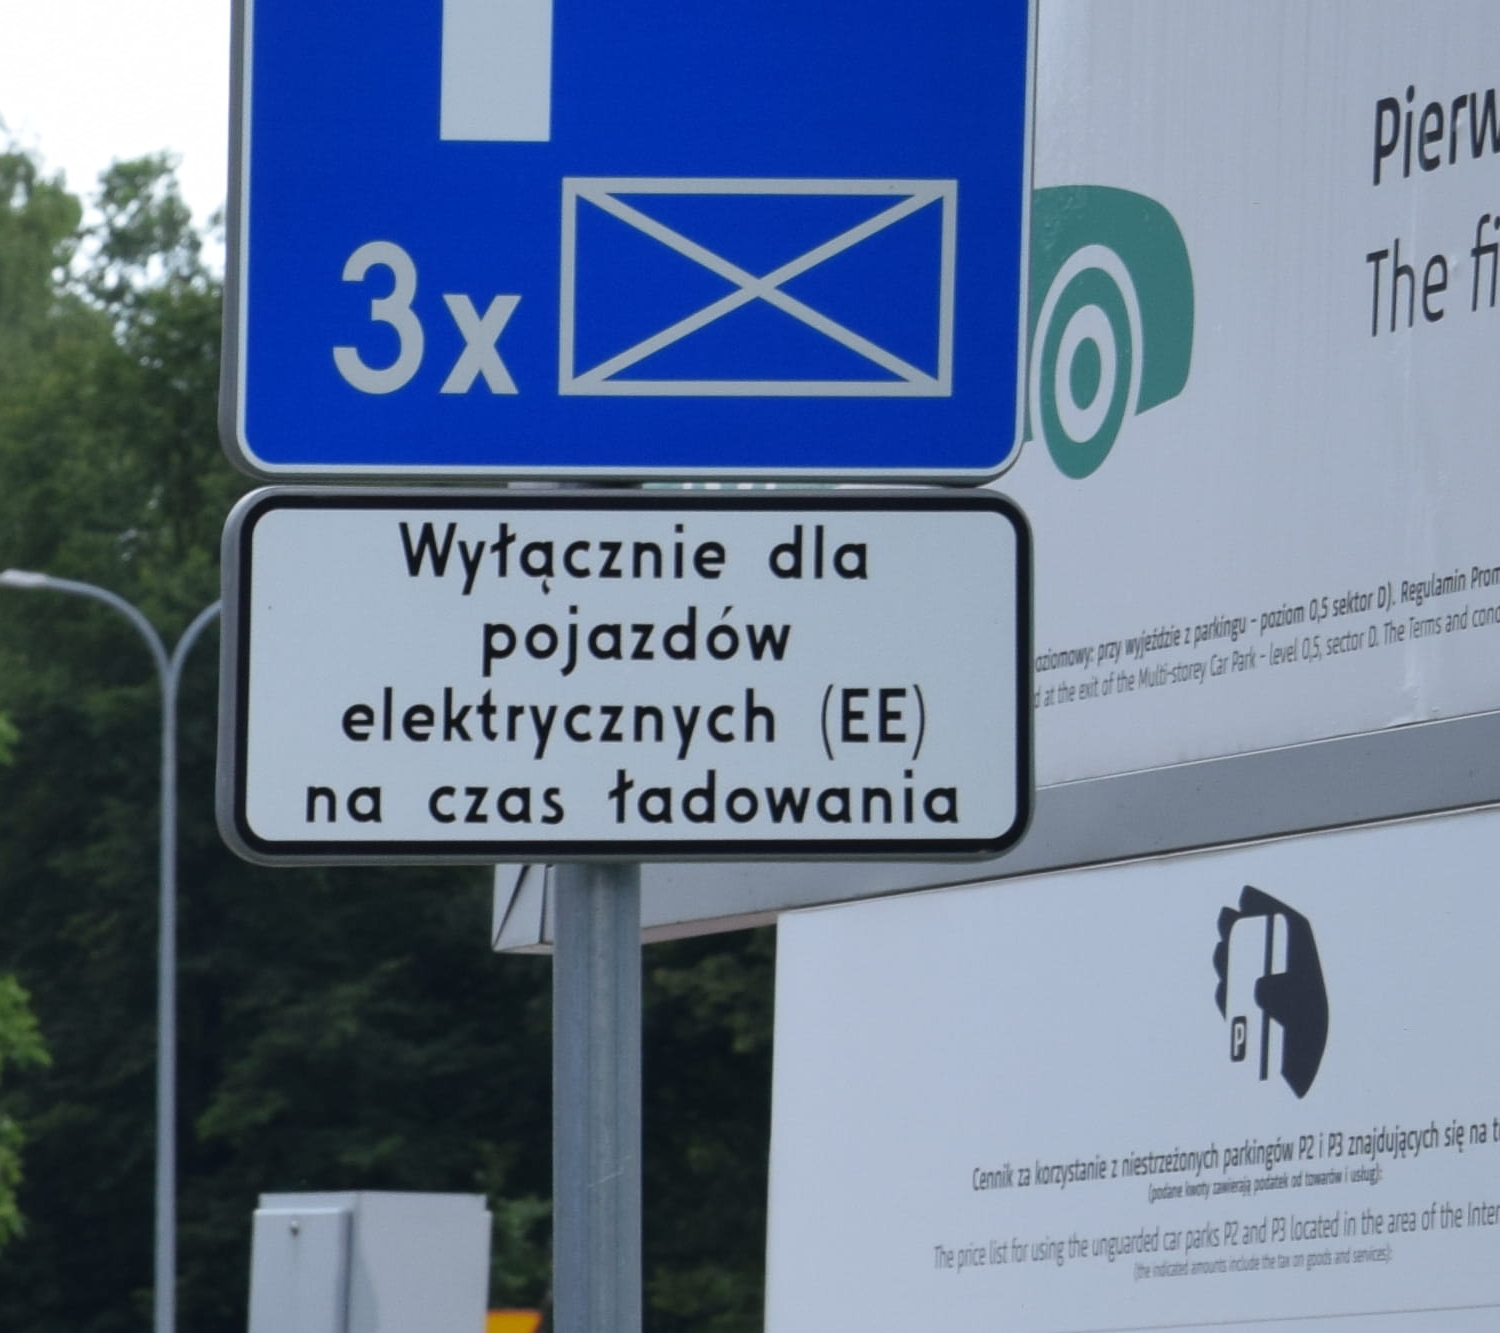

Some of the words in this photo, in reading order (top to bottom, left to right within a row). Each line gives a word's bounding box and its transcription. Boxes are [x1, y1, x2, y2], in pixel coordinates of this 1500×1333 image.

[332, 240, 522, 395] 3x
[1365, 237, 1449, 338] The
[399, 521, 727, 597] Wyłącznie
[769, 524, 870, 581] dla
[482, 604, 792, 678] pojazdów
[1097, 640, 1122, 666] przy
[1183, 629, 1191, 645] z
[1193, 614, 1247, 648] parkingu
[1260, 602, 1305, 637] poziom
[1308, 596, 1329, 625] 0,5
[1331, 589, 1374, 618] sektor
[1376, 580, 1397, 612] D).
[1400, 568, 1467, 606] Regulamin
[1043, 685, 1056, 707] at
[1057, 680, 1075, 703] the
[1078, 675, 1099, 701] exit
[1101, 671, 1114, 697] of
[1116, 669, 1135, 693] the
[1138, 661, 1206, 689] Multi-storey
[1209, 653, 1229, 677] Car
[1231, 645, 1257, 673] Park
[1269, 638, 1298, 666] level
[1302, 635, 1323, 664] 0,5,
[1325, 631, 1365, 657] sector
[1367, 625, 1380, 649] D.
[1383, 618, 1405, 646] The
[1408, 614, 1442, 640] Terms
[1445, 604, 1468, 634] and
[341, 686, 777, 760] elektrycznych
[820, 684, 927, 761] (EE)
[305, 785, 383, 825] na
[429, 785, 566, 826] czas
[608, 769, 960, 825] ładowania
[1233, 1022, 1245, 1057] P
[972, 1162, 1015, 1192] Cennik
[1017, 1167, 1031, 1188] za
[1034, 1154, 1108, 1190] korzystanie
[1110, 1159, 1118, 1180] z
[1121, 1143, 1219, 1178] niestrzeżonych
[1222, 1137, 1295, 1174] parkingów
[1298, 1132, 1315, 1161] P2
[1318, 1131, 1324, 1159] i
[1327, 1131, 1344, 1158] P3
[1347, 1120, 1440, 1162] znajdujących
[1443, 1118, 1465, 1154] się
[1469, 1122, 1488, 1146] na
[1253, 1173, 1289, 1194] podatek
[1291, 1170, 1302, 1189] od
[934, 1244, 955, 1270] The
[957, 1242, 987, 1274] price
[988, 1238, 1009, 1266] list
[1011, 1237, 1029, 1264] for
[1031, 1235, 1066, 1267] using
[1067, 1231, 1090, 1260] the
[1091, 1225, 1161, 1263] unguarded
[1162, 1228, 1183, 1252] car
[1184, 1220, 1220, 1256] parks
[1223, 1220, 1239, 1247] P2
[1241, 1216, 1268, 1246] and
[1270, 1216, 1287, 1244] P3
[1290, 1209, 1341, 1242] located
[1342, 1210, 1358, 1238] in
[1360, 1207, 1384, 1237] the
[1387, 1210, 1417, 1235] area
[1420, 1202, 1438, 1232] of
[1439, 1200, 1463, 1230] the
